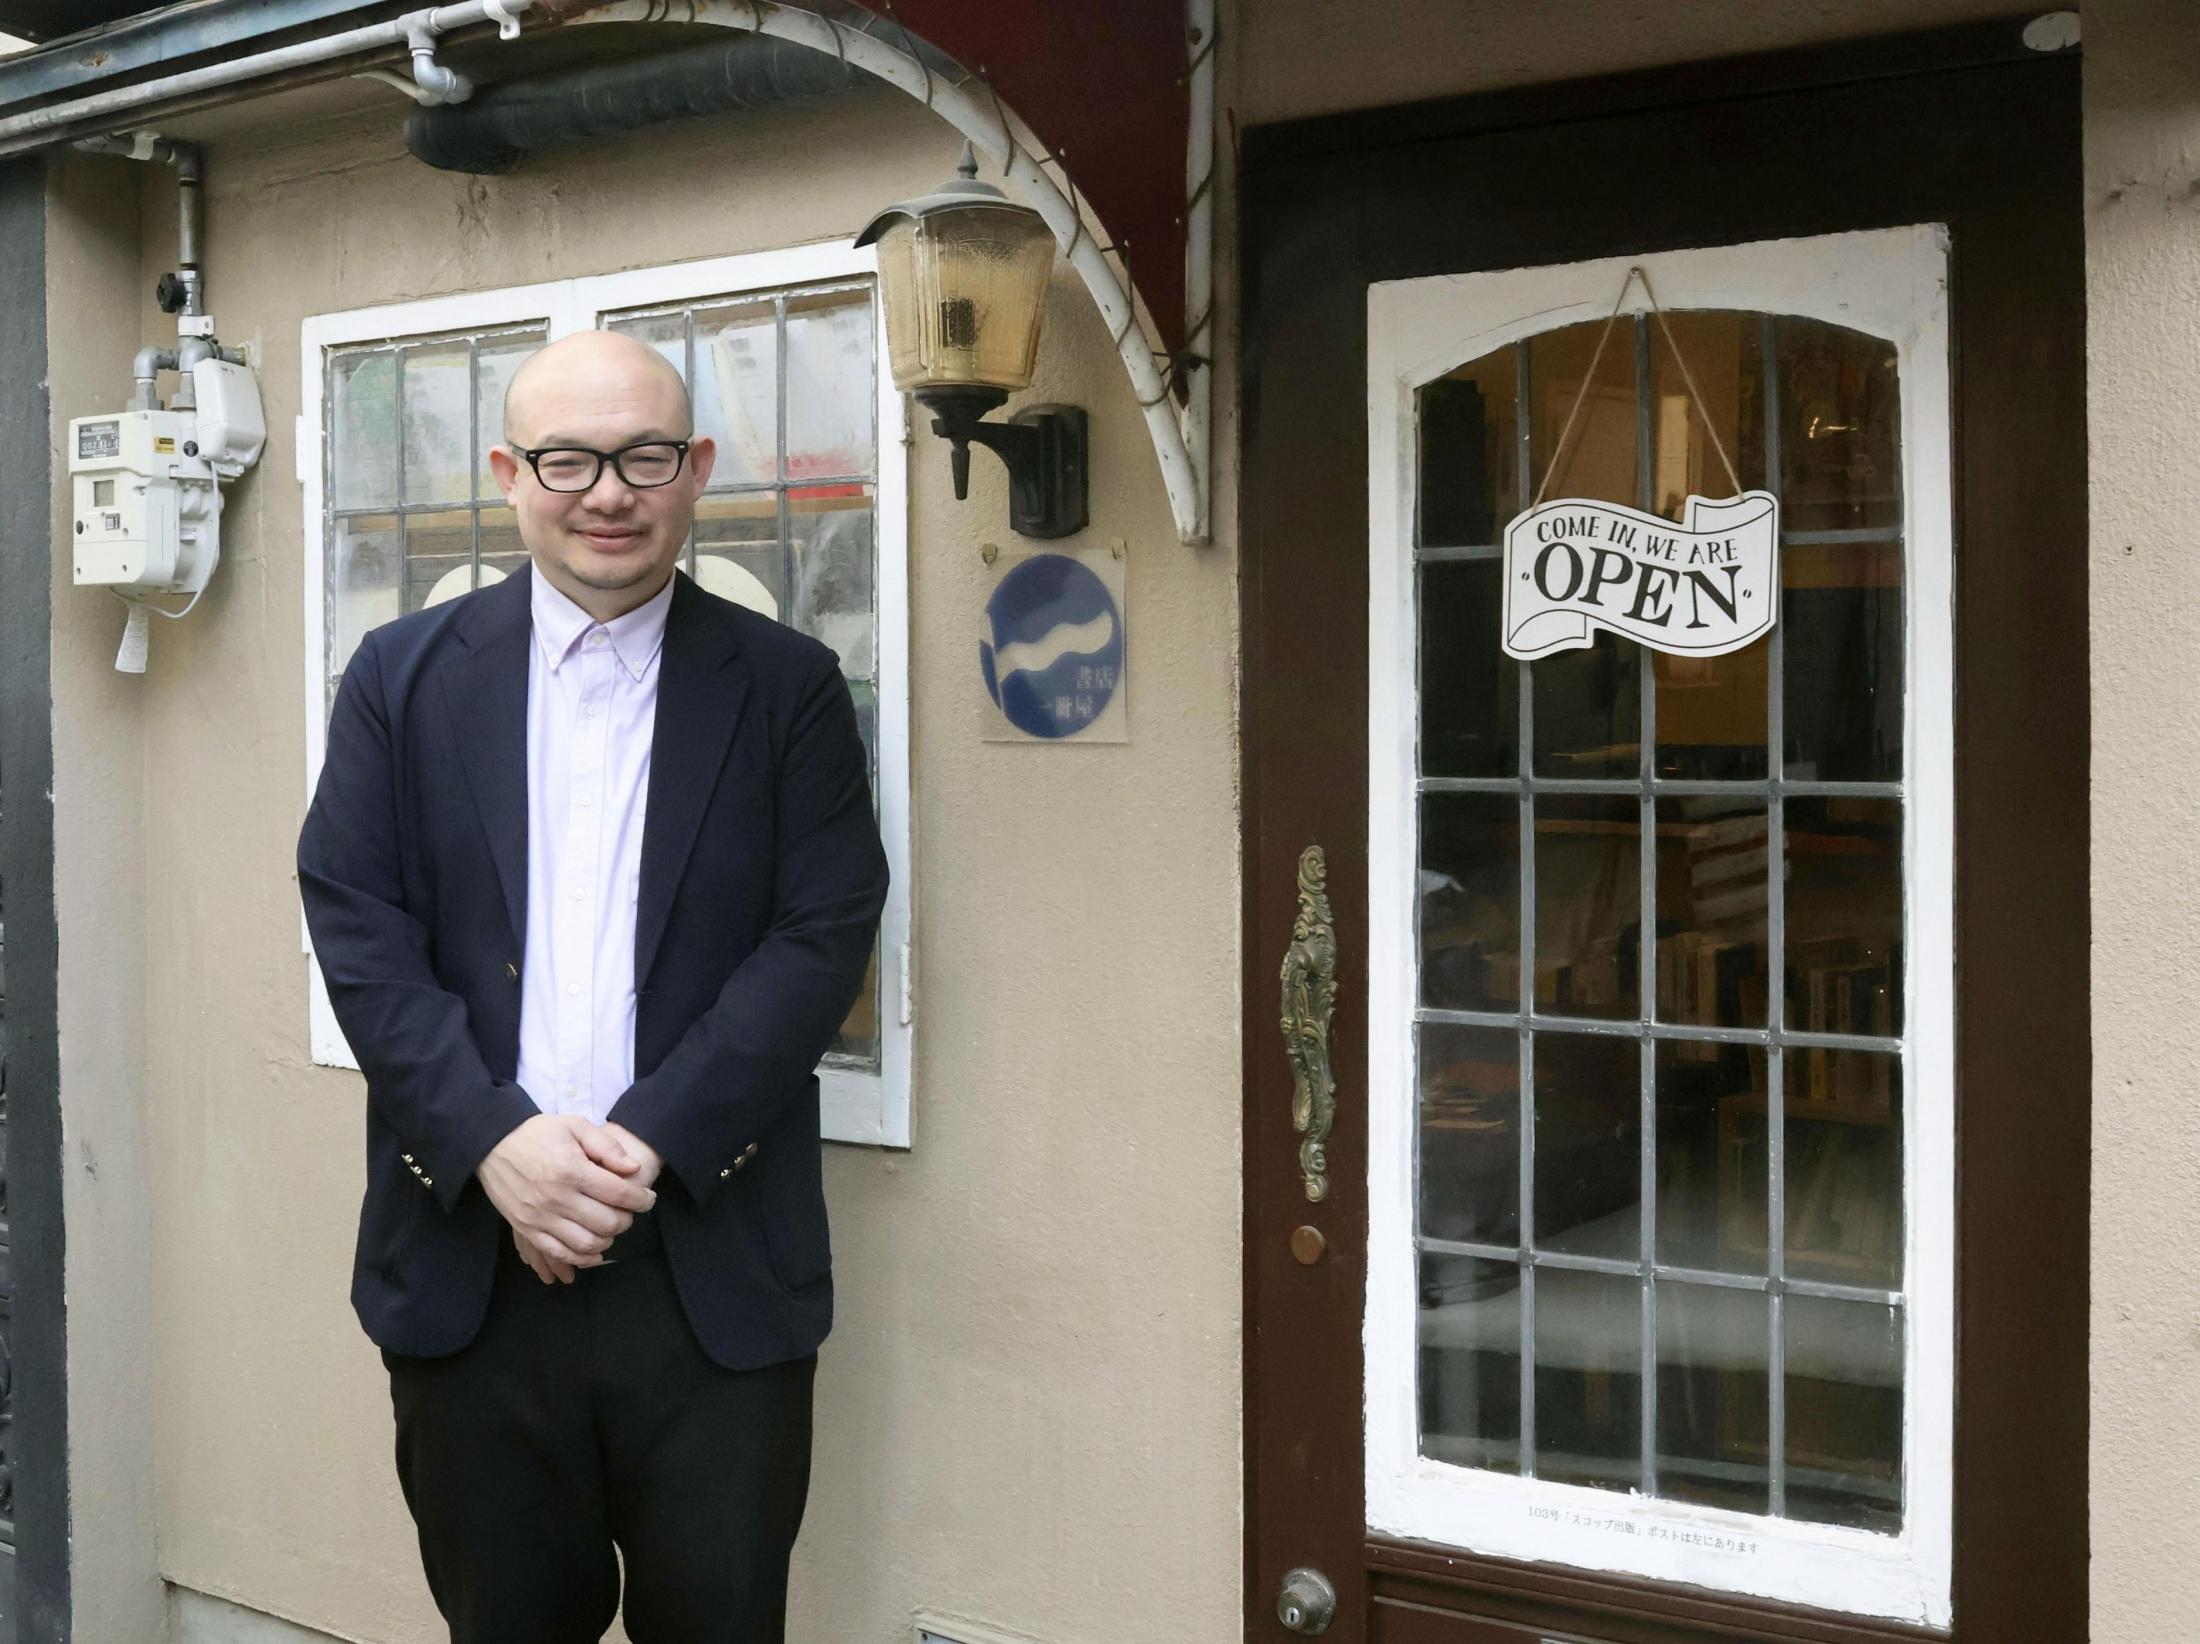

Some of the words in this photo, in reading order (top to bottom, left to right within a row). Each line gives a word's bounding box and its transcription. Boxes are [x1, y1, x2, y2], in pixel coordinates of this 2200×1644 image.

[1537, 516, 1600, 543] COME
[1647, 535, 1680, 562] WE
[1688, 538, 1738, 565] ARE
[1534, 542, 1742, 629] OPEN
